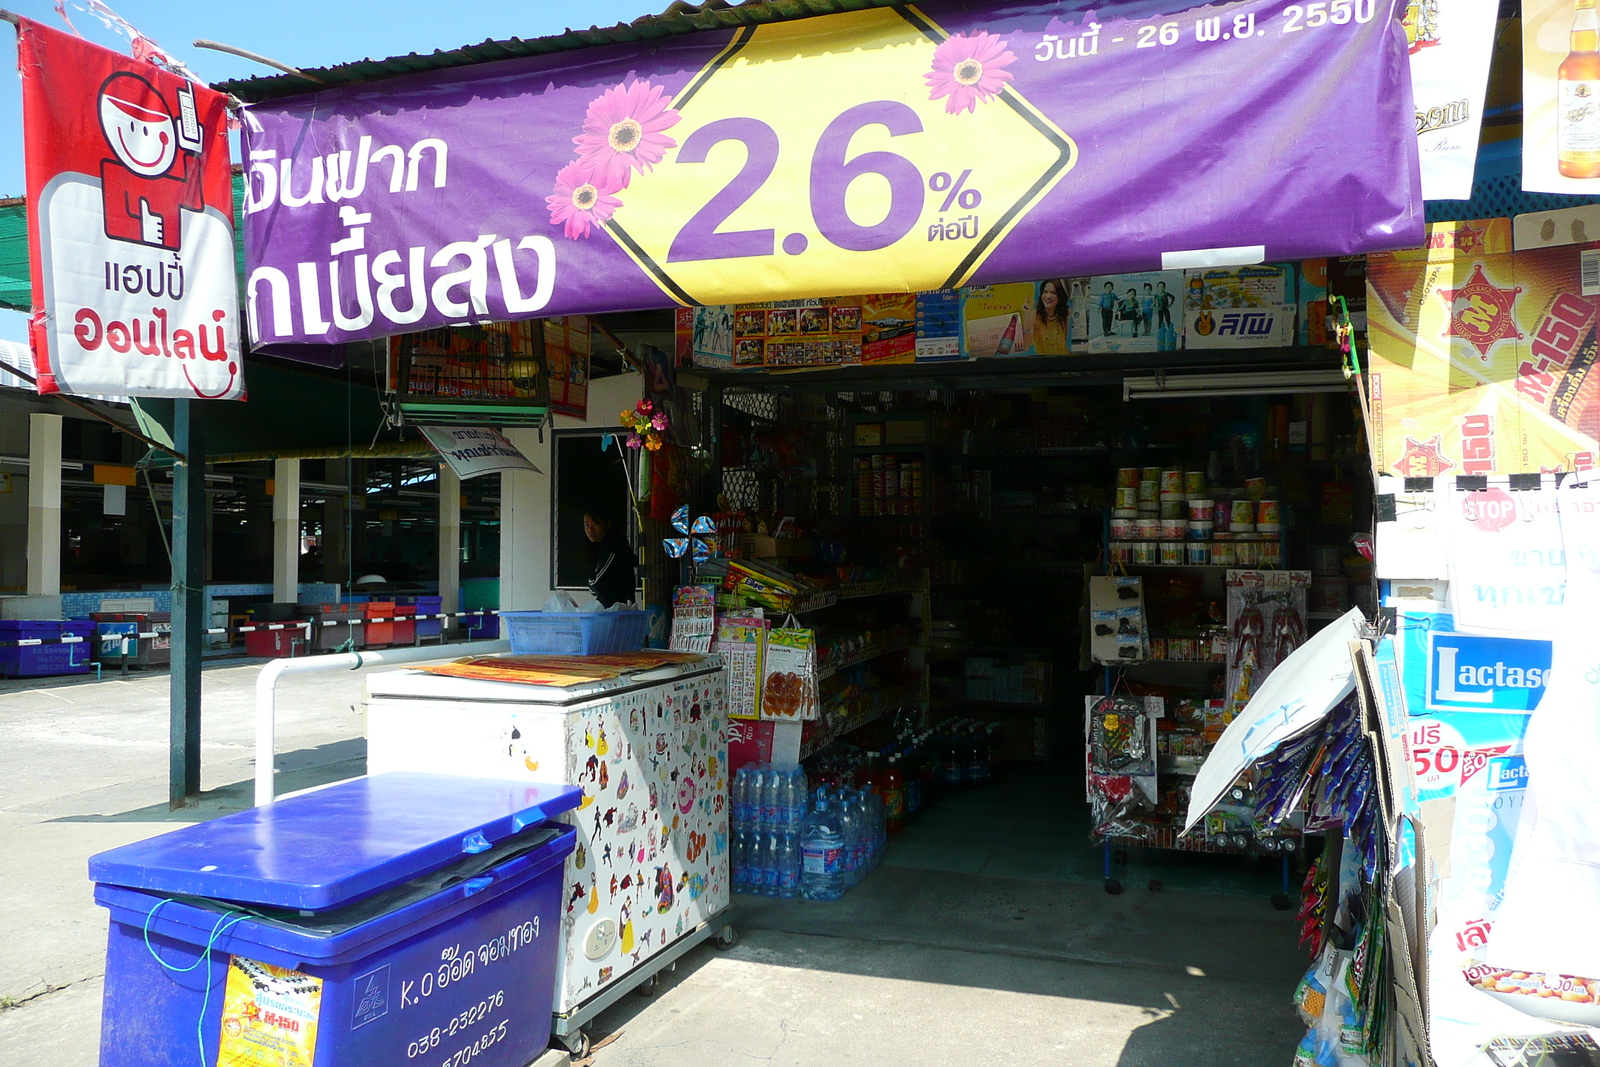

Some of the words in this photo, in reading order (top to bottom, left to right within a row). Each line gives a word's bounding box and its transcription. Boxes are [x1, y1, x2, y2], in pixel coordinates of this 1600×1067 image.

[1034, 23, 1102, 62] วันนี้
[1137, 21, 1179, 49] 26
[1195, 13, 1265, 42] พ.ย.
[1282, 0, 1375, 34] 2550
[928, 214, 979, 242] ต่อปี
[105, 253, 184, 300] แฮปปี้
[1419, 266, 1442, 305] OSOTSPA
[74, 307, 228, 362] ออนไลน์
[1514, 293, 1597, 404] M-150
[1463, 500, 1514, 519] STOP
[1266, 573, 1288, 589] 45
[1413, 746, 1459, 776] 50
[408, 990, 505, 1058] 038-232276
